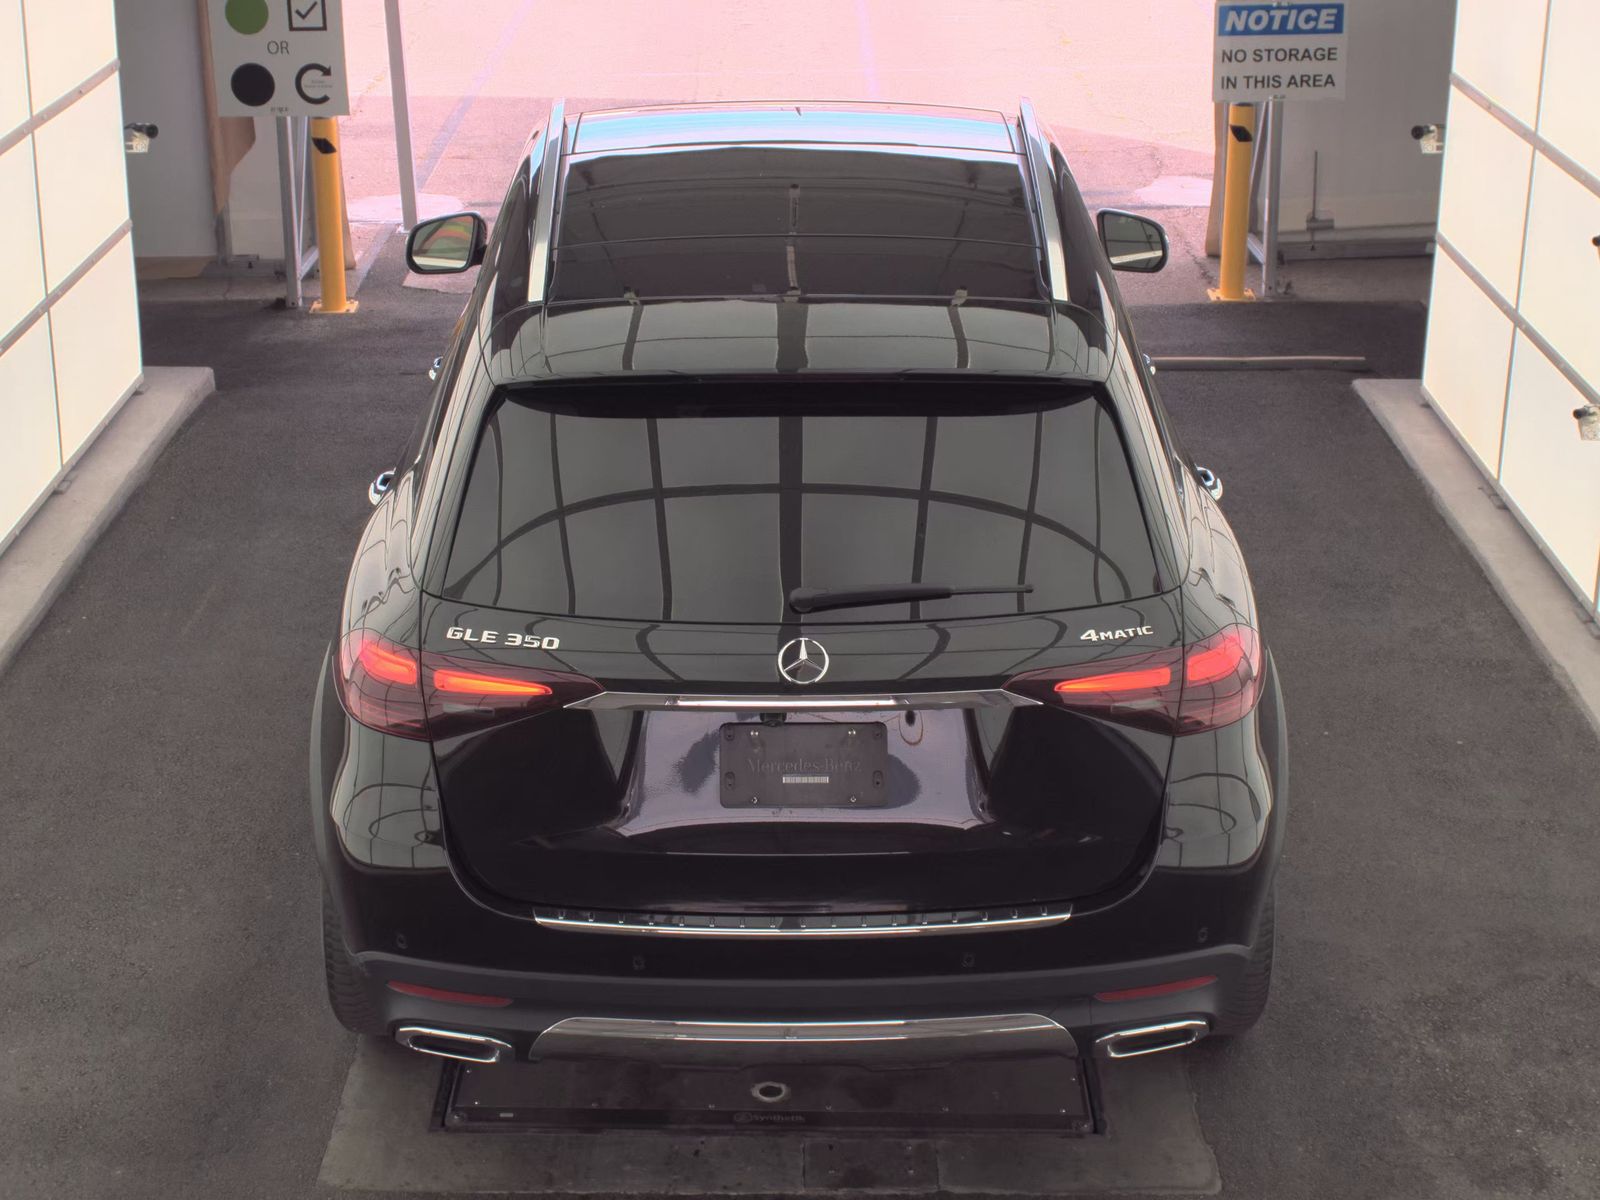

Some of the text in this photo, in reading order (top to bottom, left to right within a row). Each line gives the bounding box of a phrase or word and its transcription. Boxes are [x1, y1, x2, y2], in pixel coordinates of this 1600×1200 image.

[1225, 8, 1338, 32] NOTICE
[266, 40, 290, 55] OR
[1221, 47, 1338, 63] NO STORAGE
[1221, 74, 1336, 89] IN THIS AREA
[446, 626, 560, 650] GLE 350
[1080, 625, 1154, 641] 4MATIC
